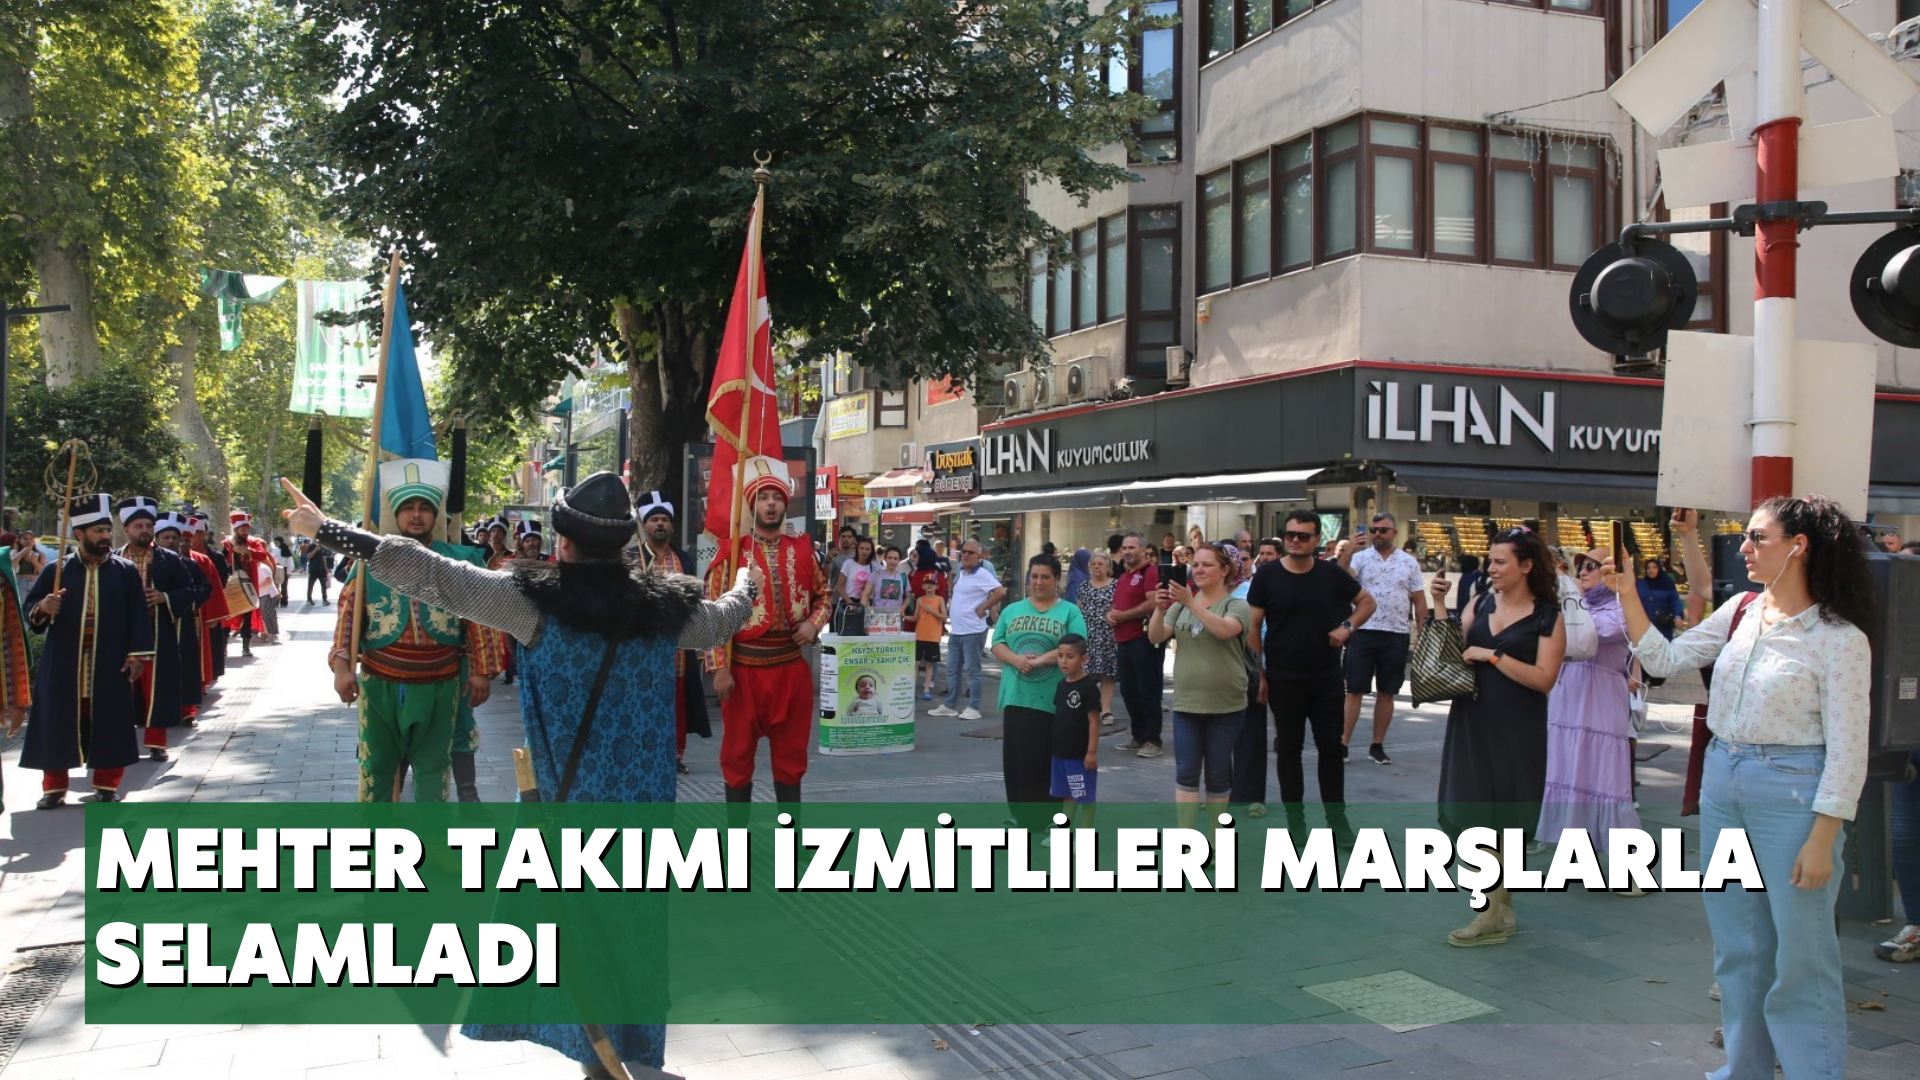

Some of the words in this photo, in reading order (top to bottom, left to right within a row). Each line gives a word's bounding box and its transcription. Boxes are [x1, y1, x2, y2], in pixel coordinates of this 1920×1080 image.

[1367, 380, 1556, 453] İLHAN
[935, 445, 974, 474] boşnak
[979, 428, 1051, 477] İLHAN
[1057, 439, 1151, 469] KUYUMCULUK
[933, 472, 974, 493] BÖREKÇİ
[1008, 615, 1067, 638] BERKELEY
[876, 645, 905, 654] TÜRKİYE
